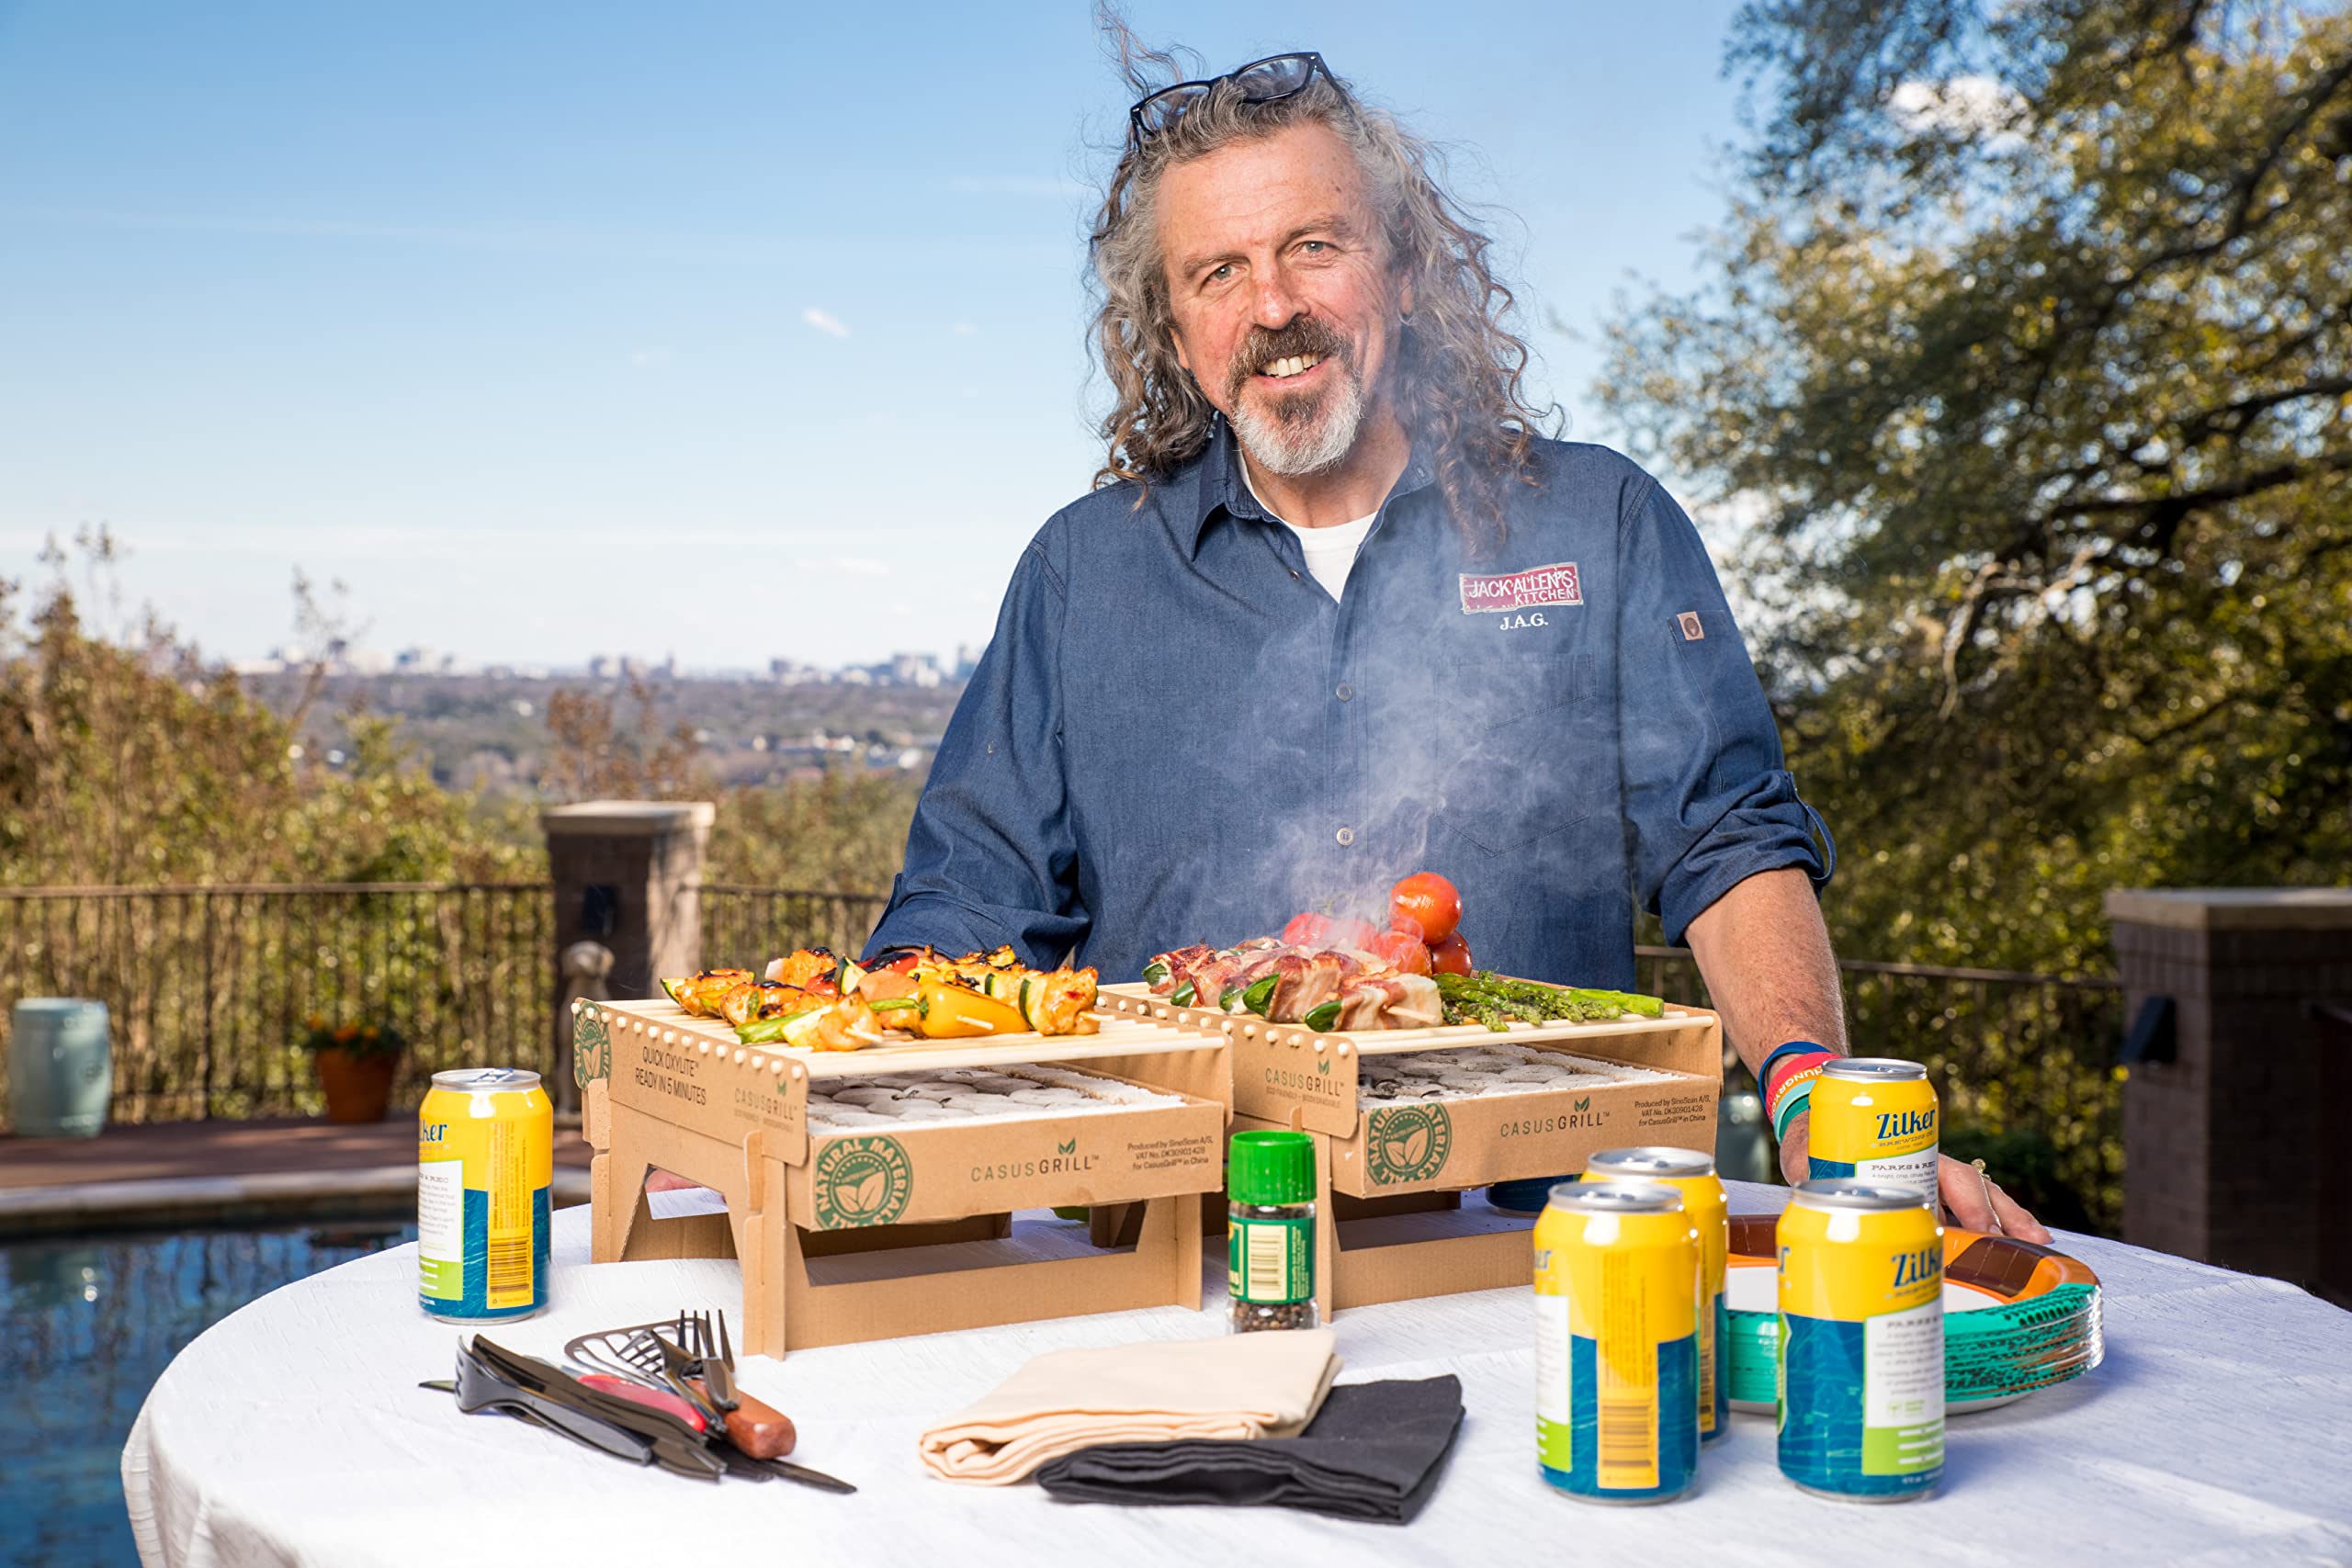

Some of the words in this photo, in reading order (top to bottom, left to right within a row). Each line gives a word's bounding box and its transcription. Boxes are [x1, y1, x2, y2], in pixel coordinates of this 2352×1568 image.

[1469, 579, 1511, 598] JACK
[1514, 587, 1575, 606] KITCHEN
[1499, 612, 1549, 631] J.A.G.
[642, 1045, 664, 1067] QUICK
[635, 1067, 657, 1090] READY
[658, 1075, 666, 1093] IN
[667, 1077, 673, 1095] 5
[673, 1077, 707, 1106] MINUTES
[1634, 1099, 1663, 1108] Produced
[1663, 1098, 1670, 1107] by
[1671, 1097, 1698, 1105] SinoScan
[1641, 1109, 1652, 1117] VAT
[1638, 1119, 1647, 1127] for
[1876, 1109, 1936, 1140] Zilker
[815, 1138, 863, 1213] NATURAL
[868, 1138, 907, 1225] MATERIALS
